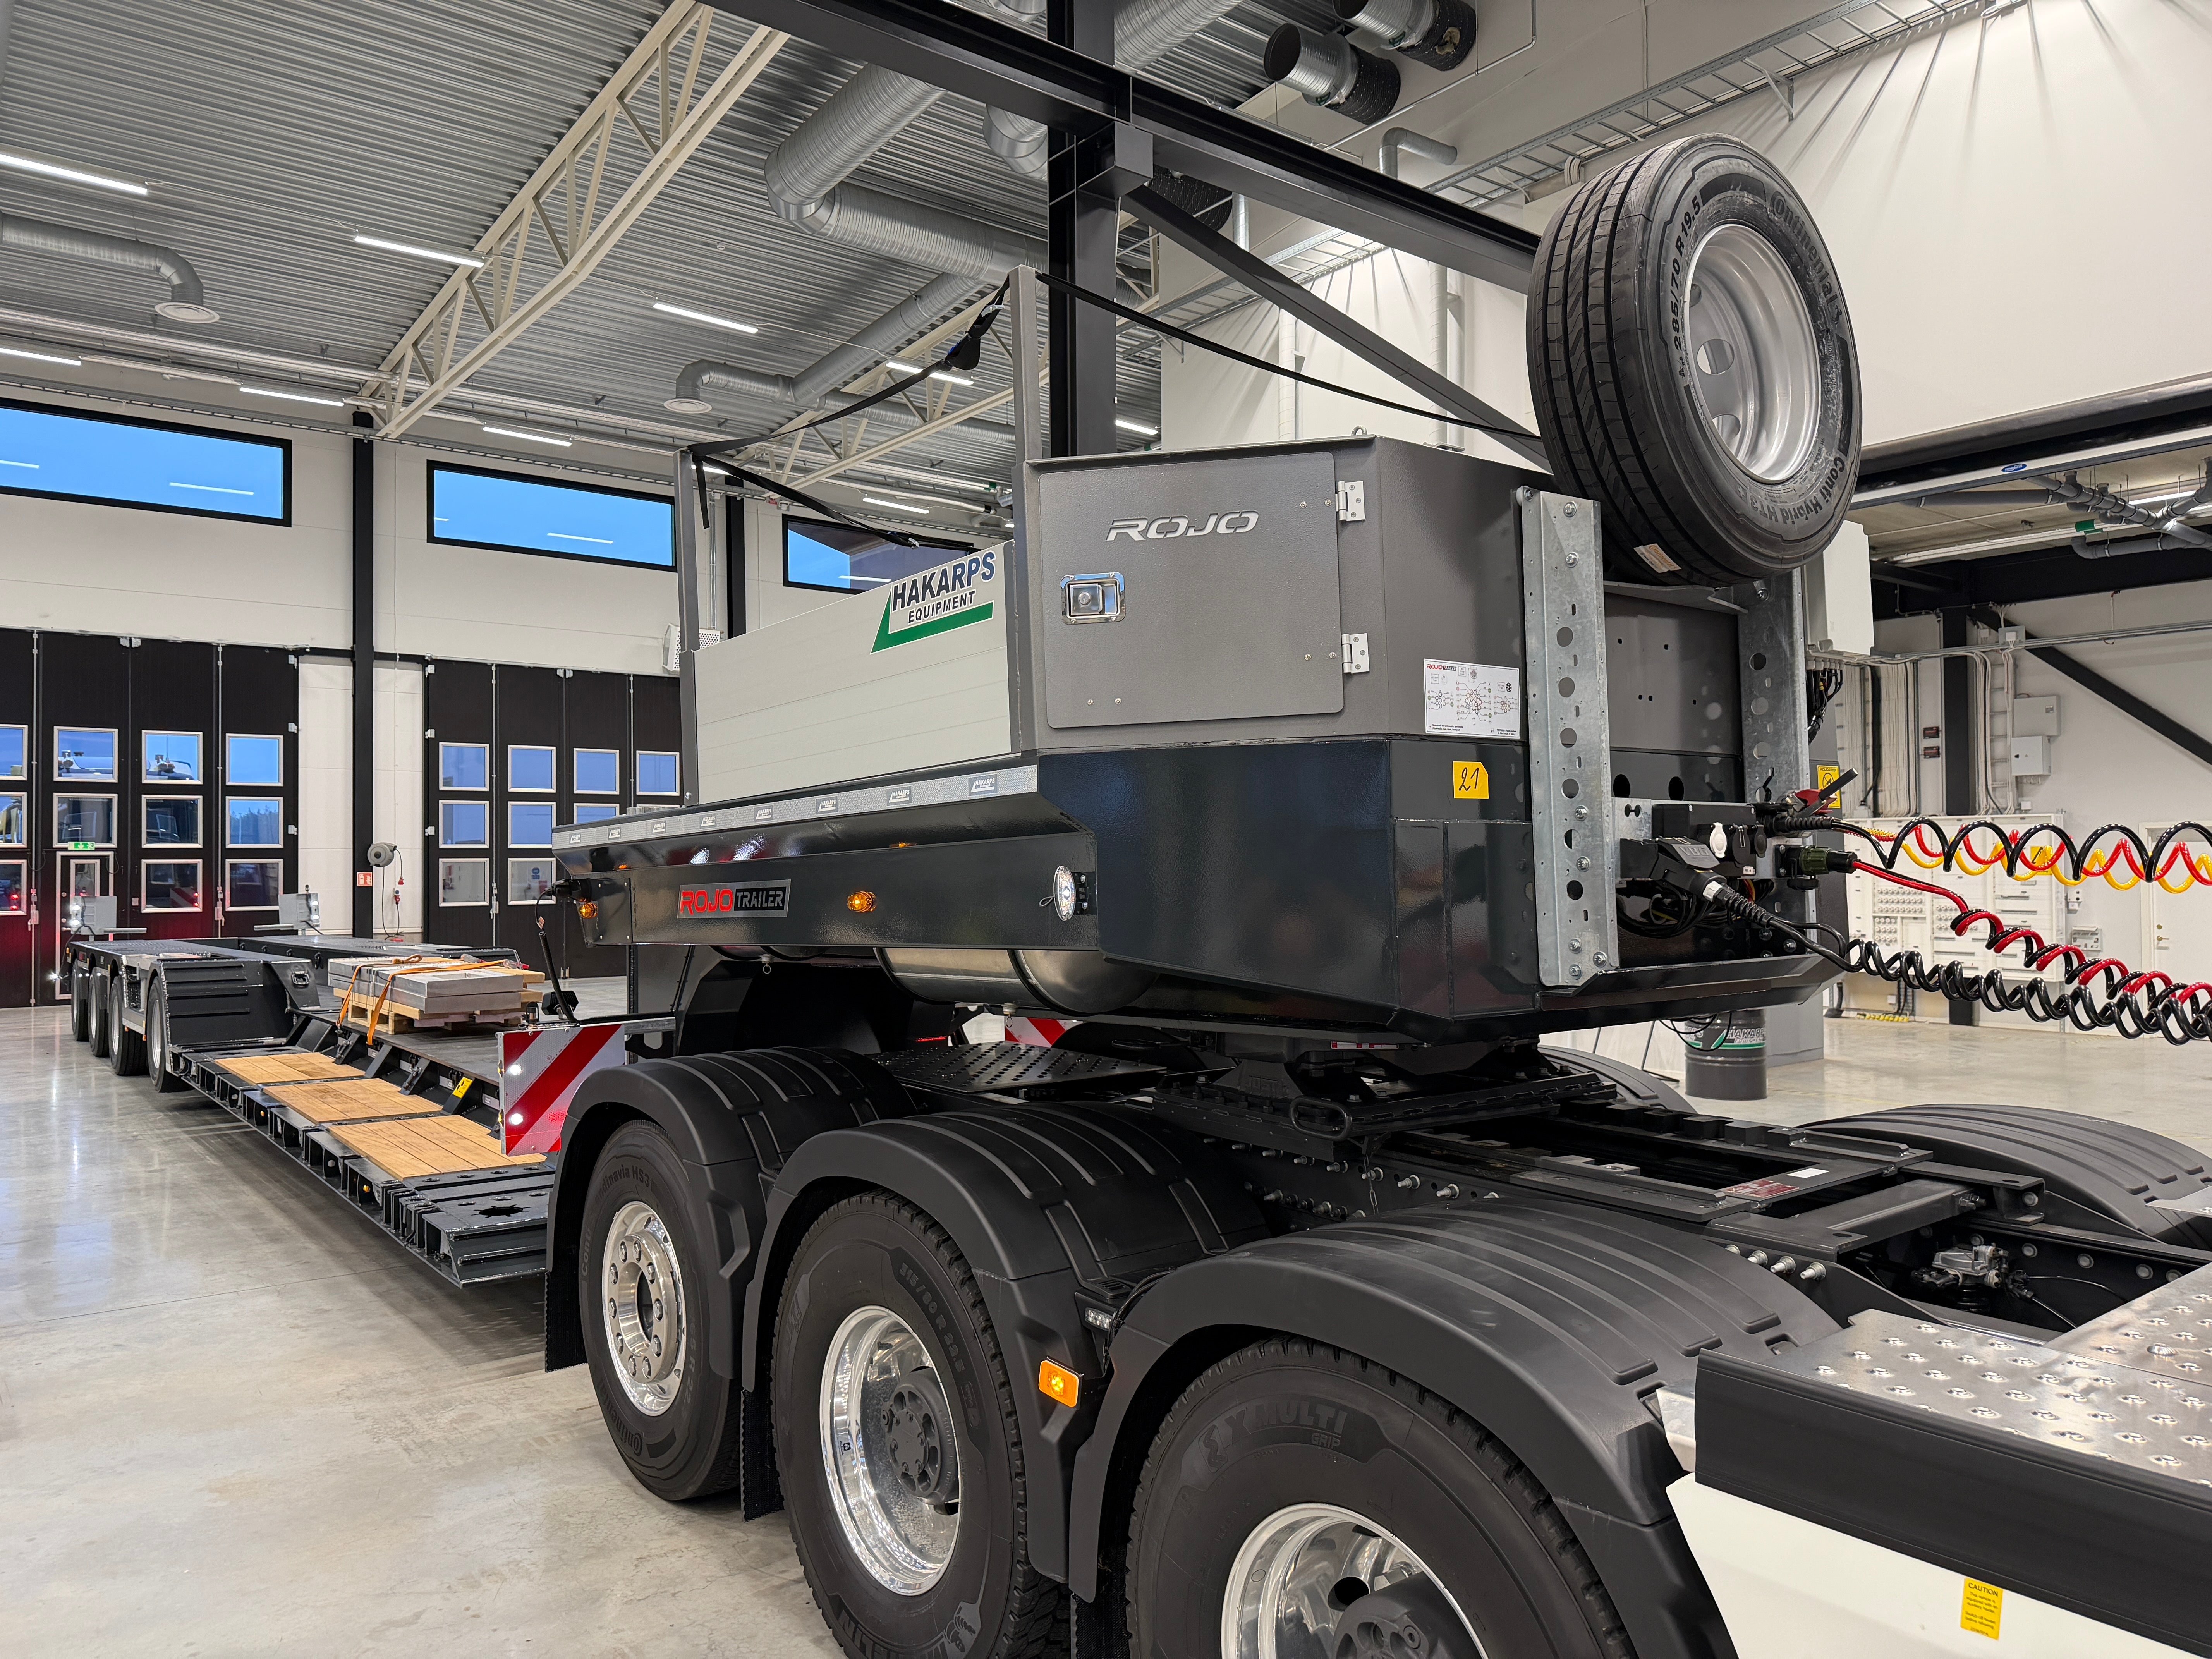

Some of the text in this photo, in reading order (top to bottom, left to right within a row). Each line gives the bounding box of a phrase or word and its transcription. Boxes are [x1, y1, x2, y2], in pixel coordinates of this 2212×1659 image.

[1670, 195, 1700, 351] 285/70 R 19.5
[1819, 456, 1844, 504] Conti
[1783, 495, 1822, 524] Hybrid
[1106, 510, 1259, 541] ROJO
[892, 551, 995, 612] HAKARPS
[908, 590, 975, 624] EQUIPMENT
[975, 778, 995, 786] HAKARPS
[1458, 767, 1479, 791] 21
[680, 888, 783, 915] ROJO TRAILER
[1726, 1027, 1766, 1039] HAKARP
[632, 1165, 650, 1188] HS3
[900, 1262, 965, 1372] 315/80 R 22.5
[1255, 1400, 1348, 1434] MULTI
[1311, 1433, 1341, 1449] GRIP
[1968, 1582, 1998, 1597] CAUTION
